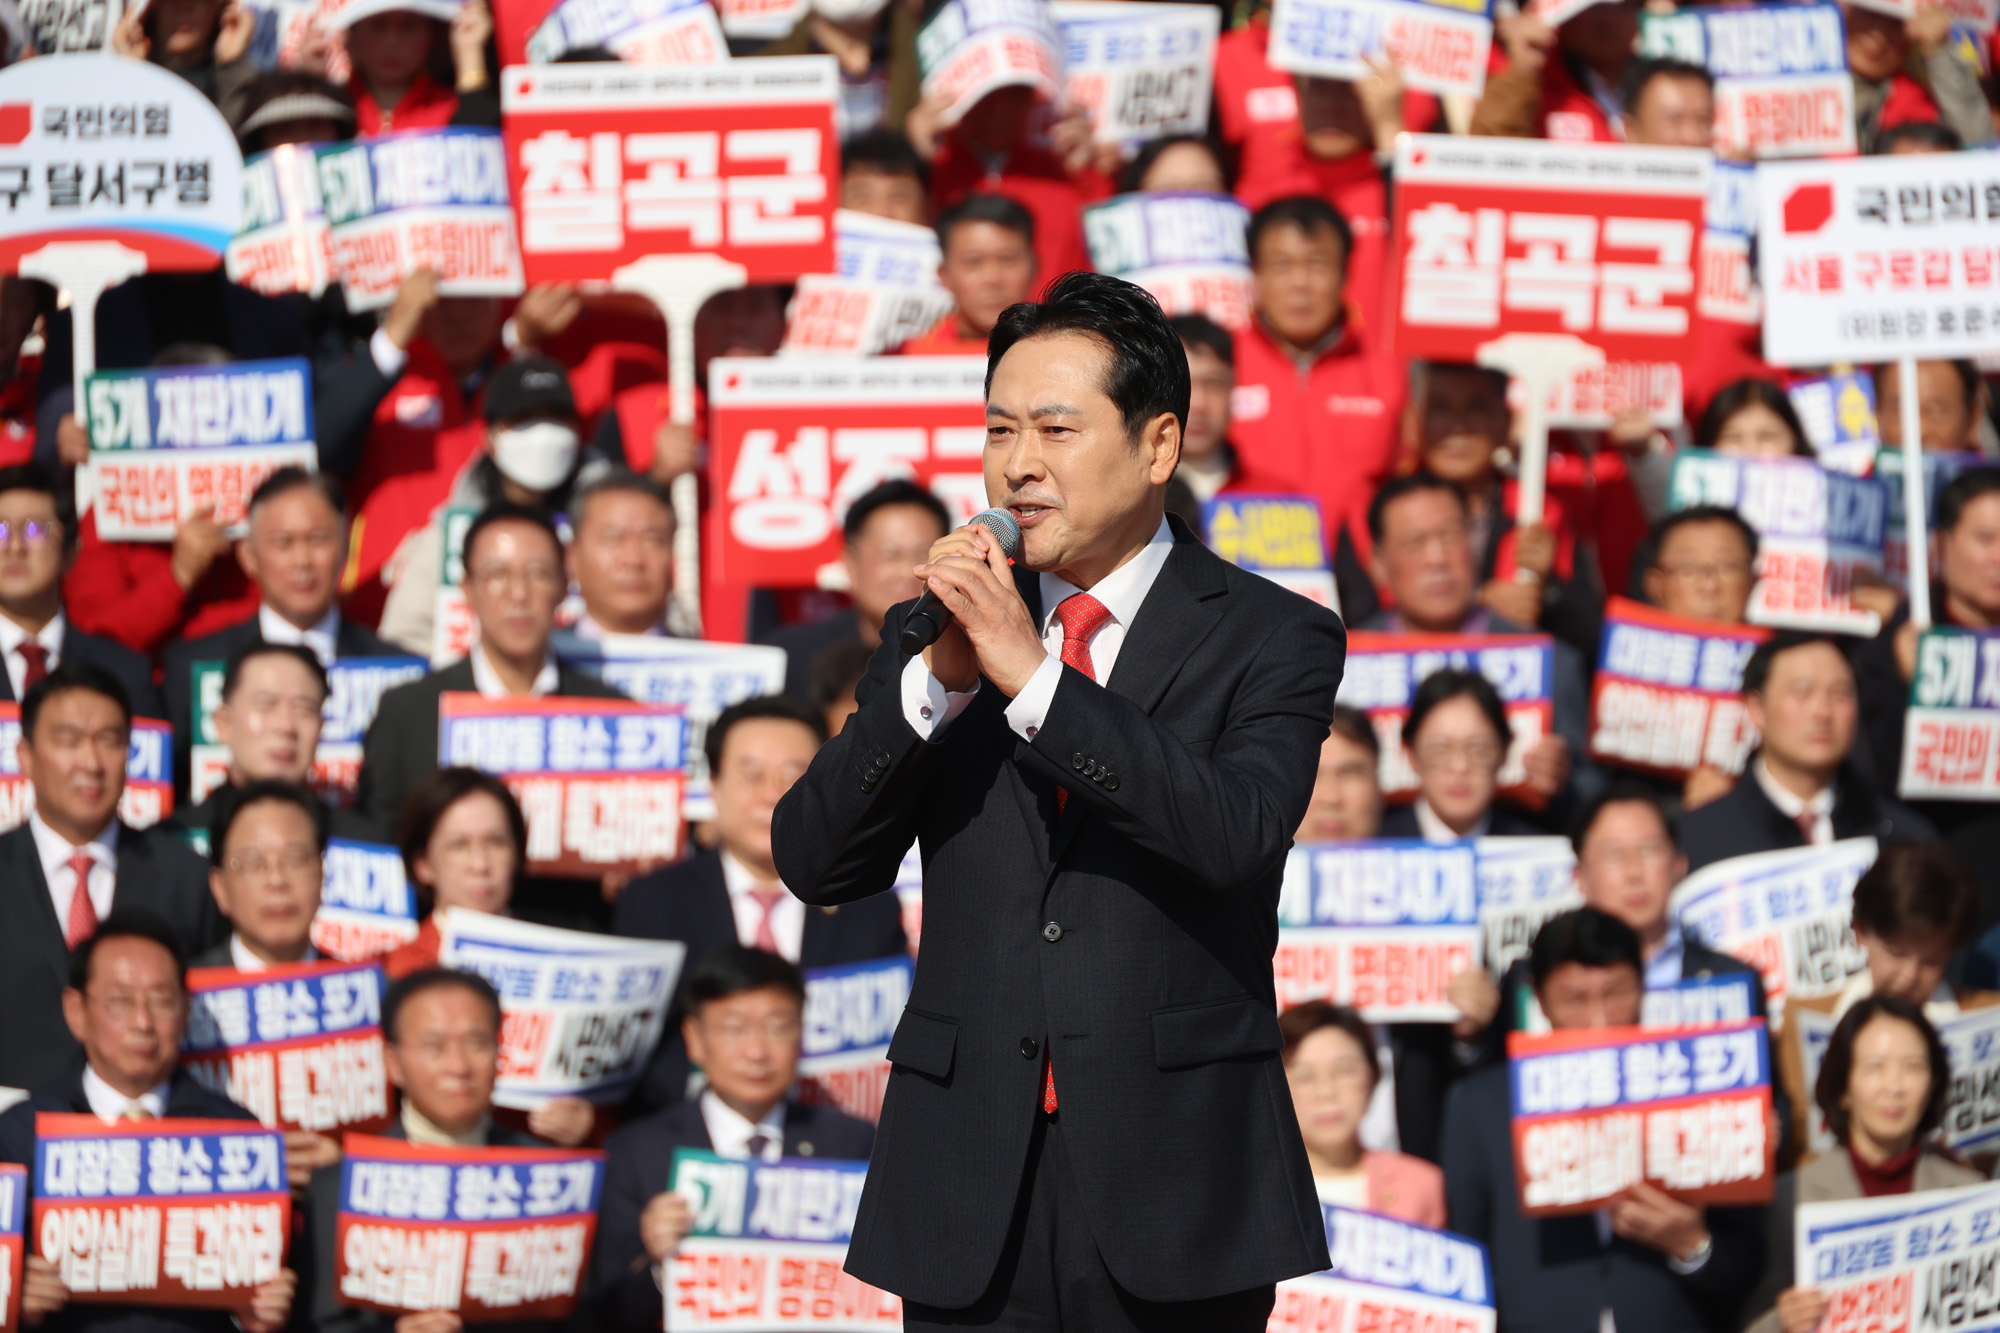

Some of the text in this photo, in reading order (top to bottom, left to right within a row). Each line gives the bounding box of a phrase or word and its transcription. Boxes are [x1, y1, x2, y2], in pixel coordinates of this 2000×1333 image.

[42, 102, 170, 139] 국민의힘
[46, 160, 211, 207] 달서구병
[520, 128, 828, 253] 칠곡군
[1402, 202, 1695, 337] 칠곡군
[1781, 252, 1844, 297] 서울
[1855, 247, 1953, 293] 구로갑
[88, 370, 307, 449] 5개 재판재개
[99, 463, 179, 527] 국민의
[1606, 621, 1700, 690] 대장동
[1917, 633, 1977, 707] 5개
[450, 714, 546, 773] 대장동
[548, 714, 613, 772] 항소
[614, 714, 683, 771] 포기
[1915, 721, 1991, 784] 국민의
[563, 778, 681, 863] 특검하라
[1314, 847, 1475, 925] 재판재개
[1791, 912, 1869, 985] 사망선
[254, 983, 318, 1043] 항소
[320, 968, 381, 1030] 포기
[277, 1034, 388, 1132] 특검하라
[1518, 1028, 1760, 1114] 대장동 항소 포기
[44, 1132, 280, 1197] 대장동 항소 포기
[1521, 1096, 1766, 1208] 외압실체 특검하라
[348, 1159, 597, 1221] 대장동 항소 포기
[163, 1200, 284, 1290] 특검하라
[340, 1220, 588, 1312] 외압실체 특검하라
[1329, 1208, 1488, 1303] 재판재개
[1813, 1230, 1899, 1284] 대장동
[1906, 1218, 1962, 1265] 항소
[674, 1252, 767, 1325] 국민의
